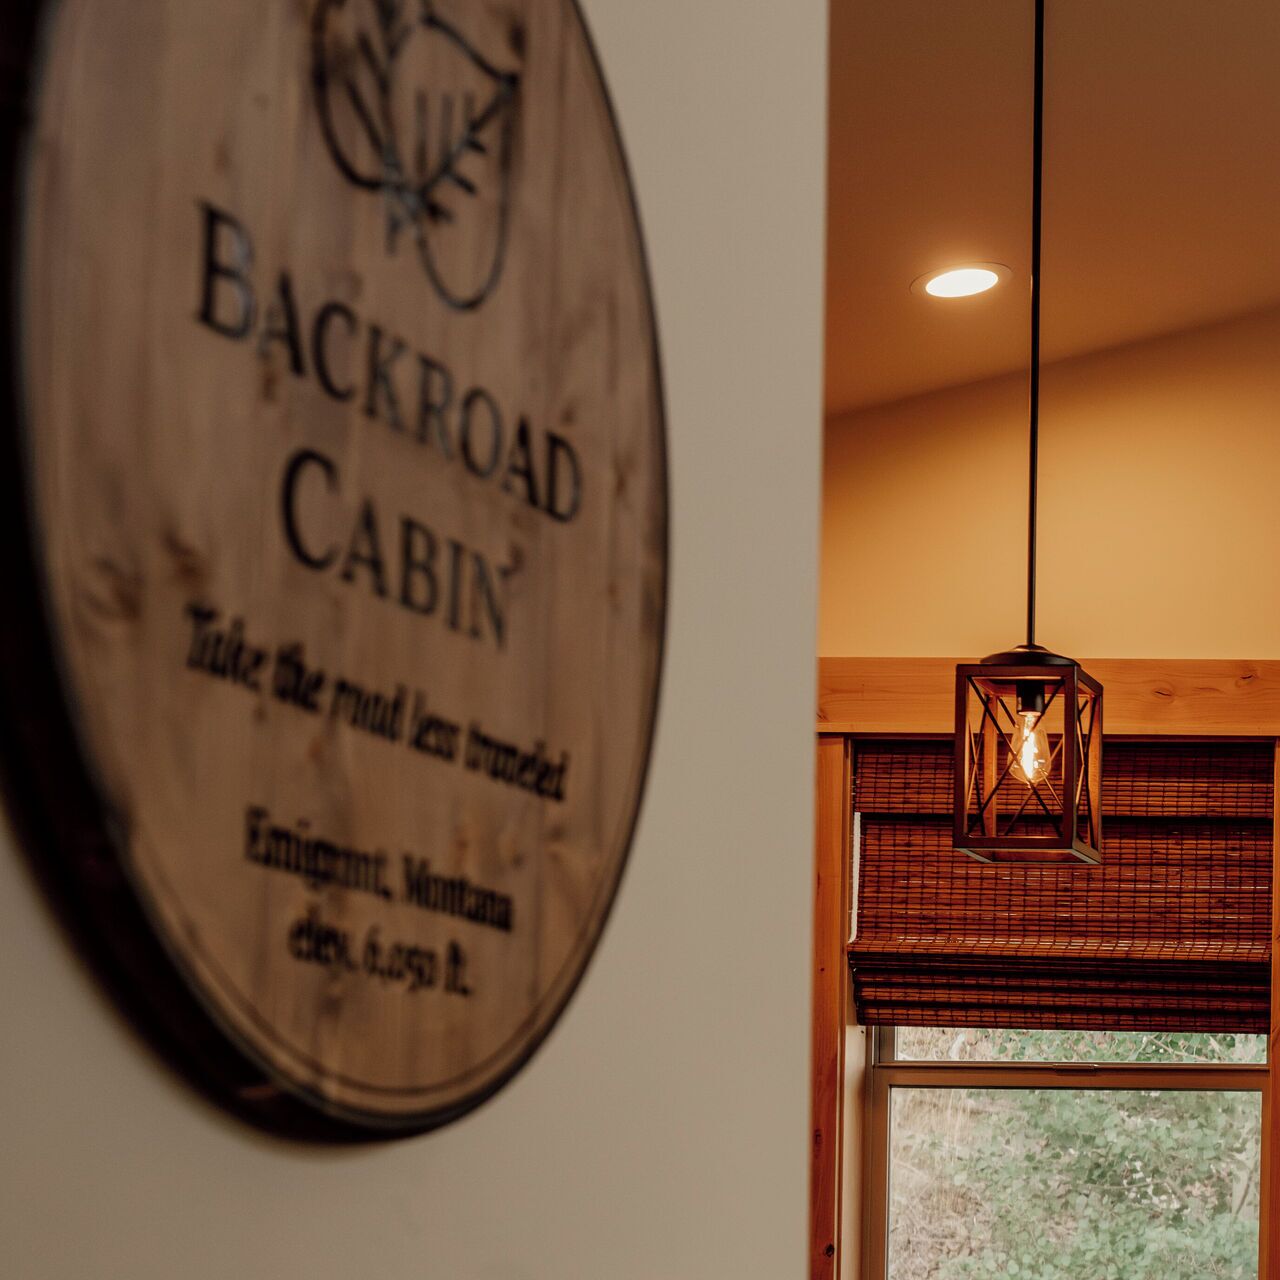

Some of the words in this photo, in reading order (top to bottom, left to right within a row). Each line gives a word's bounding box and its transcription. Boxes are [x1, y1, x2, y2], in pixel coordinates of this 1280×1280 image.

[195, 197, 584, 525] BACKROAD
[281, 450, 507, 652] CABIN
[185, 602, 268, 692] Take
[272, 640, 325, 714] the
[329, 678, 407, 744] road
[407, 686, 459, 763] less
[462, 723, 570, 803] traveled
[244, 804, 393, 902] Emigrant,
[401, 814, 514, 934] Montana
